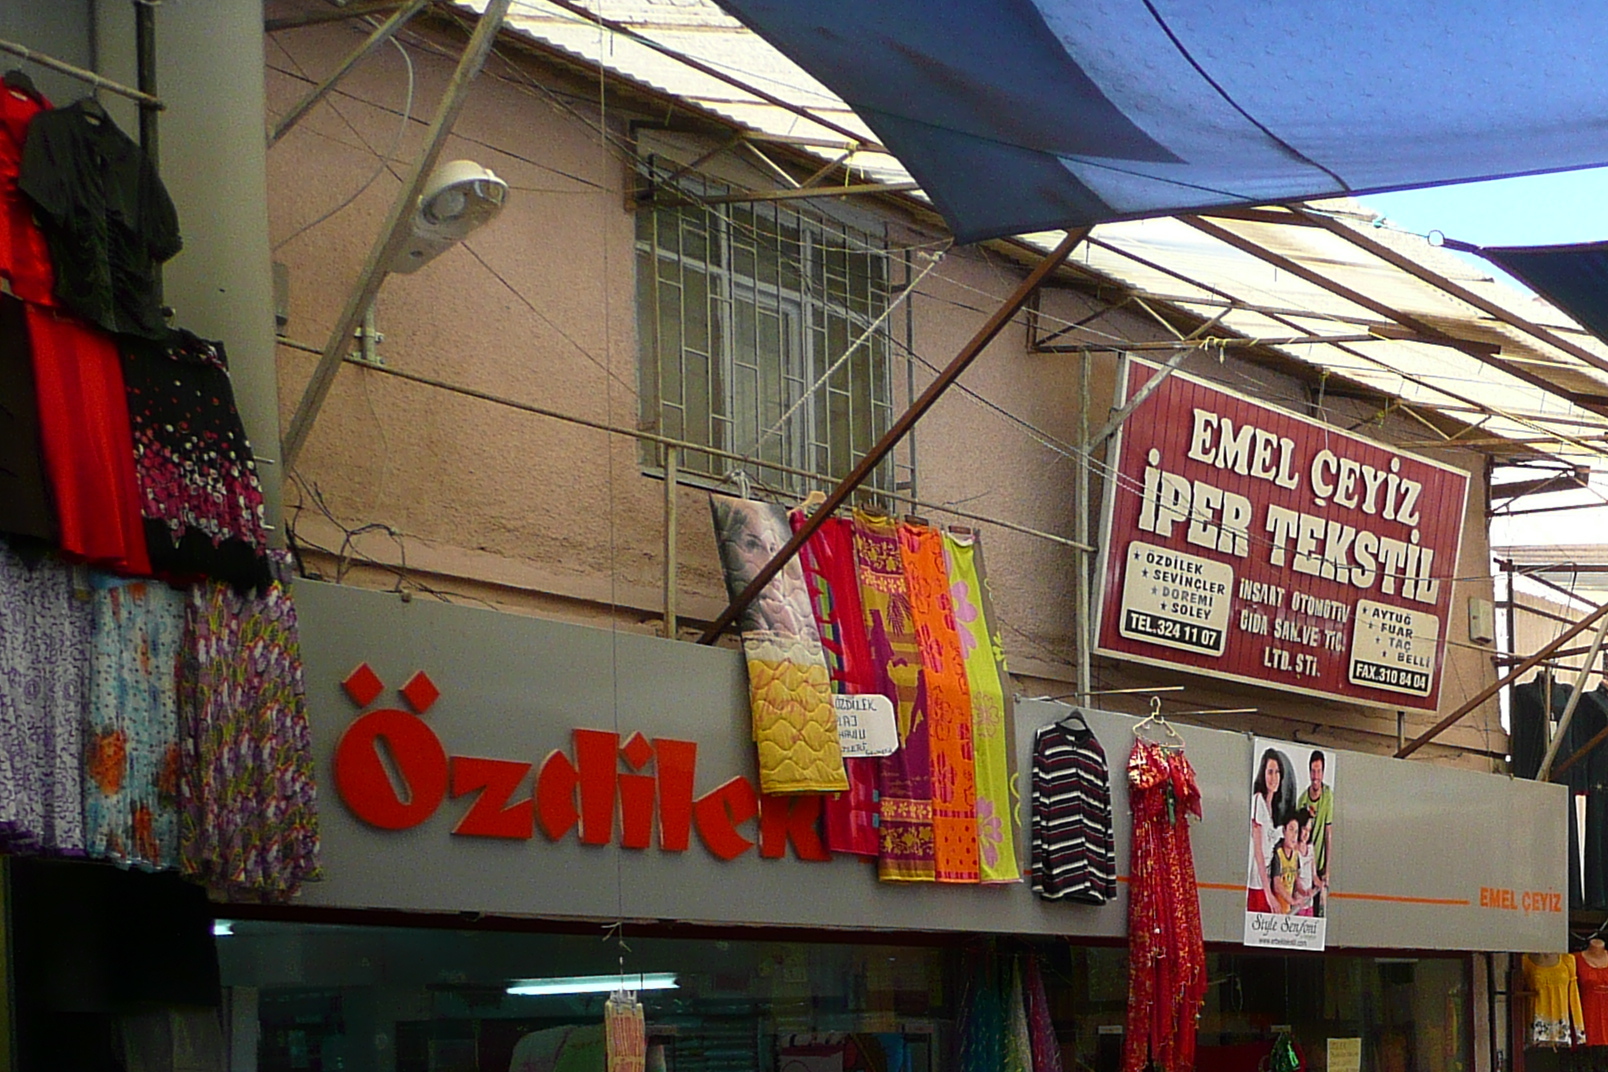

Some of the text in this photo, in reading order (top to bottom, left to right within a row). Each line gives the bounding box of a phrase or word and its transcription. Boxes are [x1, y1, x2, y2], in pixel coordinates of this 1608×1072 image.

[1187, 407, 1422, 527] EMEL ÇEYİZ
[1138, 448, 1441, 605] İPER TEKSTİL
[1145, 548, 1204, 575] ÖZDİLEK
[1152, 568, 1226, 596] SEVİNÇLER
[1171, 602, 1212, 621] SOLEY
[1371, 607, 1412, 626] AYTUĞ
[1184, 625, 1198, 643] 11
[1201, 629, 1218, 647] 07
[1380, 622, 1414, 640] FUAR
[1389, 637, 1412, 653] TAÇ
[1264, 646, 1293, 671] LTD.
[1479, 886, 1562, 918] EMEL ÇEYİZ
[1251, 913, 1319, 937] Style Senfoni
